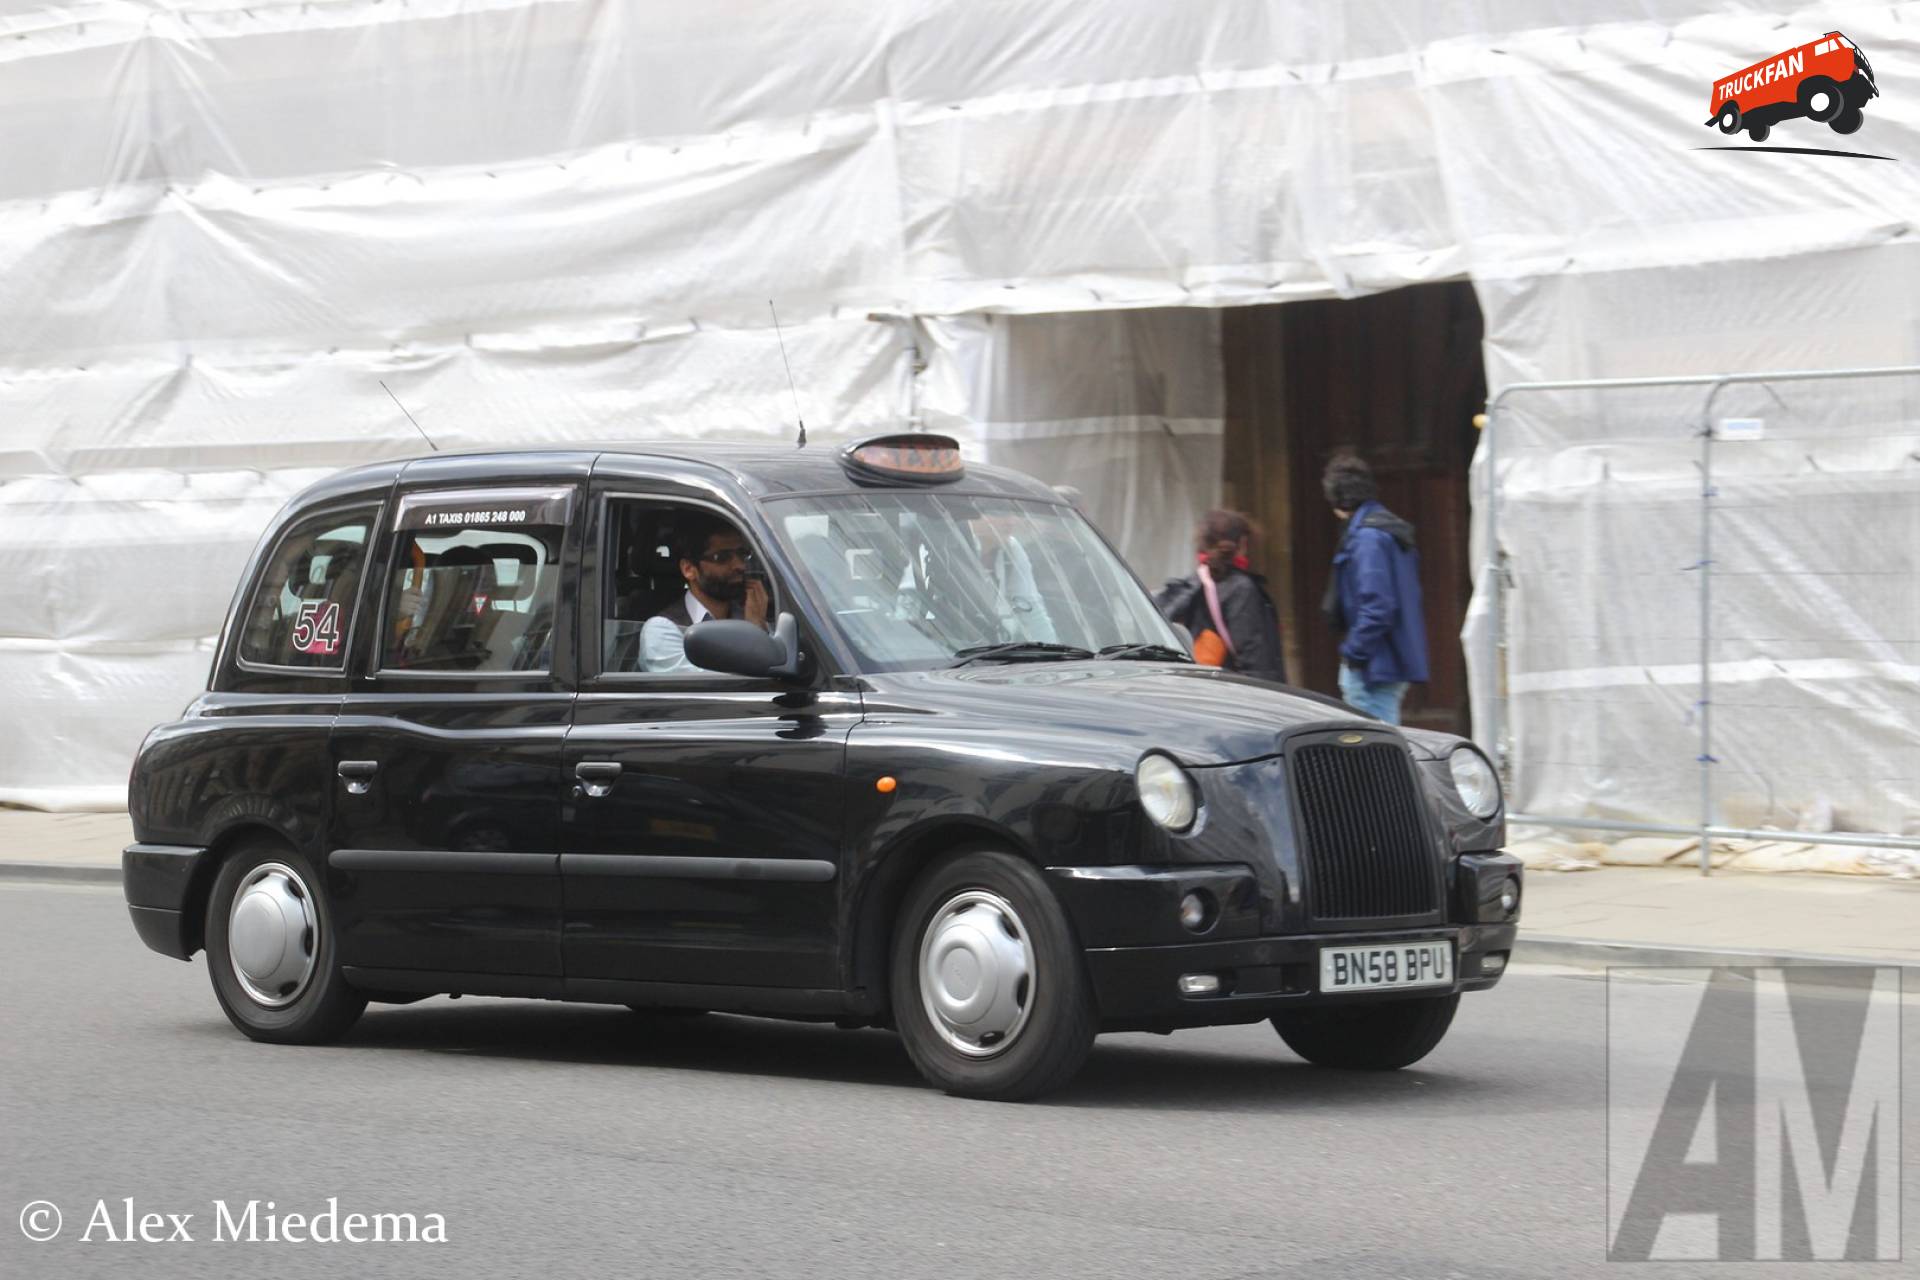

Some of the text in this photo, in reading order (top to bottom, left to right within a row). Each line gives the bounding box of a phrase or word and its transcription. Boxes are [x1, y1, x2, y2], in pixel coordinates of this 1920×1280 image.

[424, 513, 437, 525] A1
[439, 512, 463, 524] TAXIS
[464, 511, 490, 524] 01865
[509, 510, 526, 521] 000
[293, 601, 340, 651] 54
[1333, 947, 1445, 986] BN58 BPU
